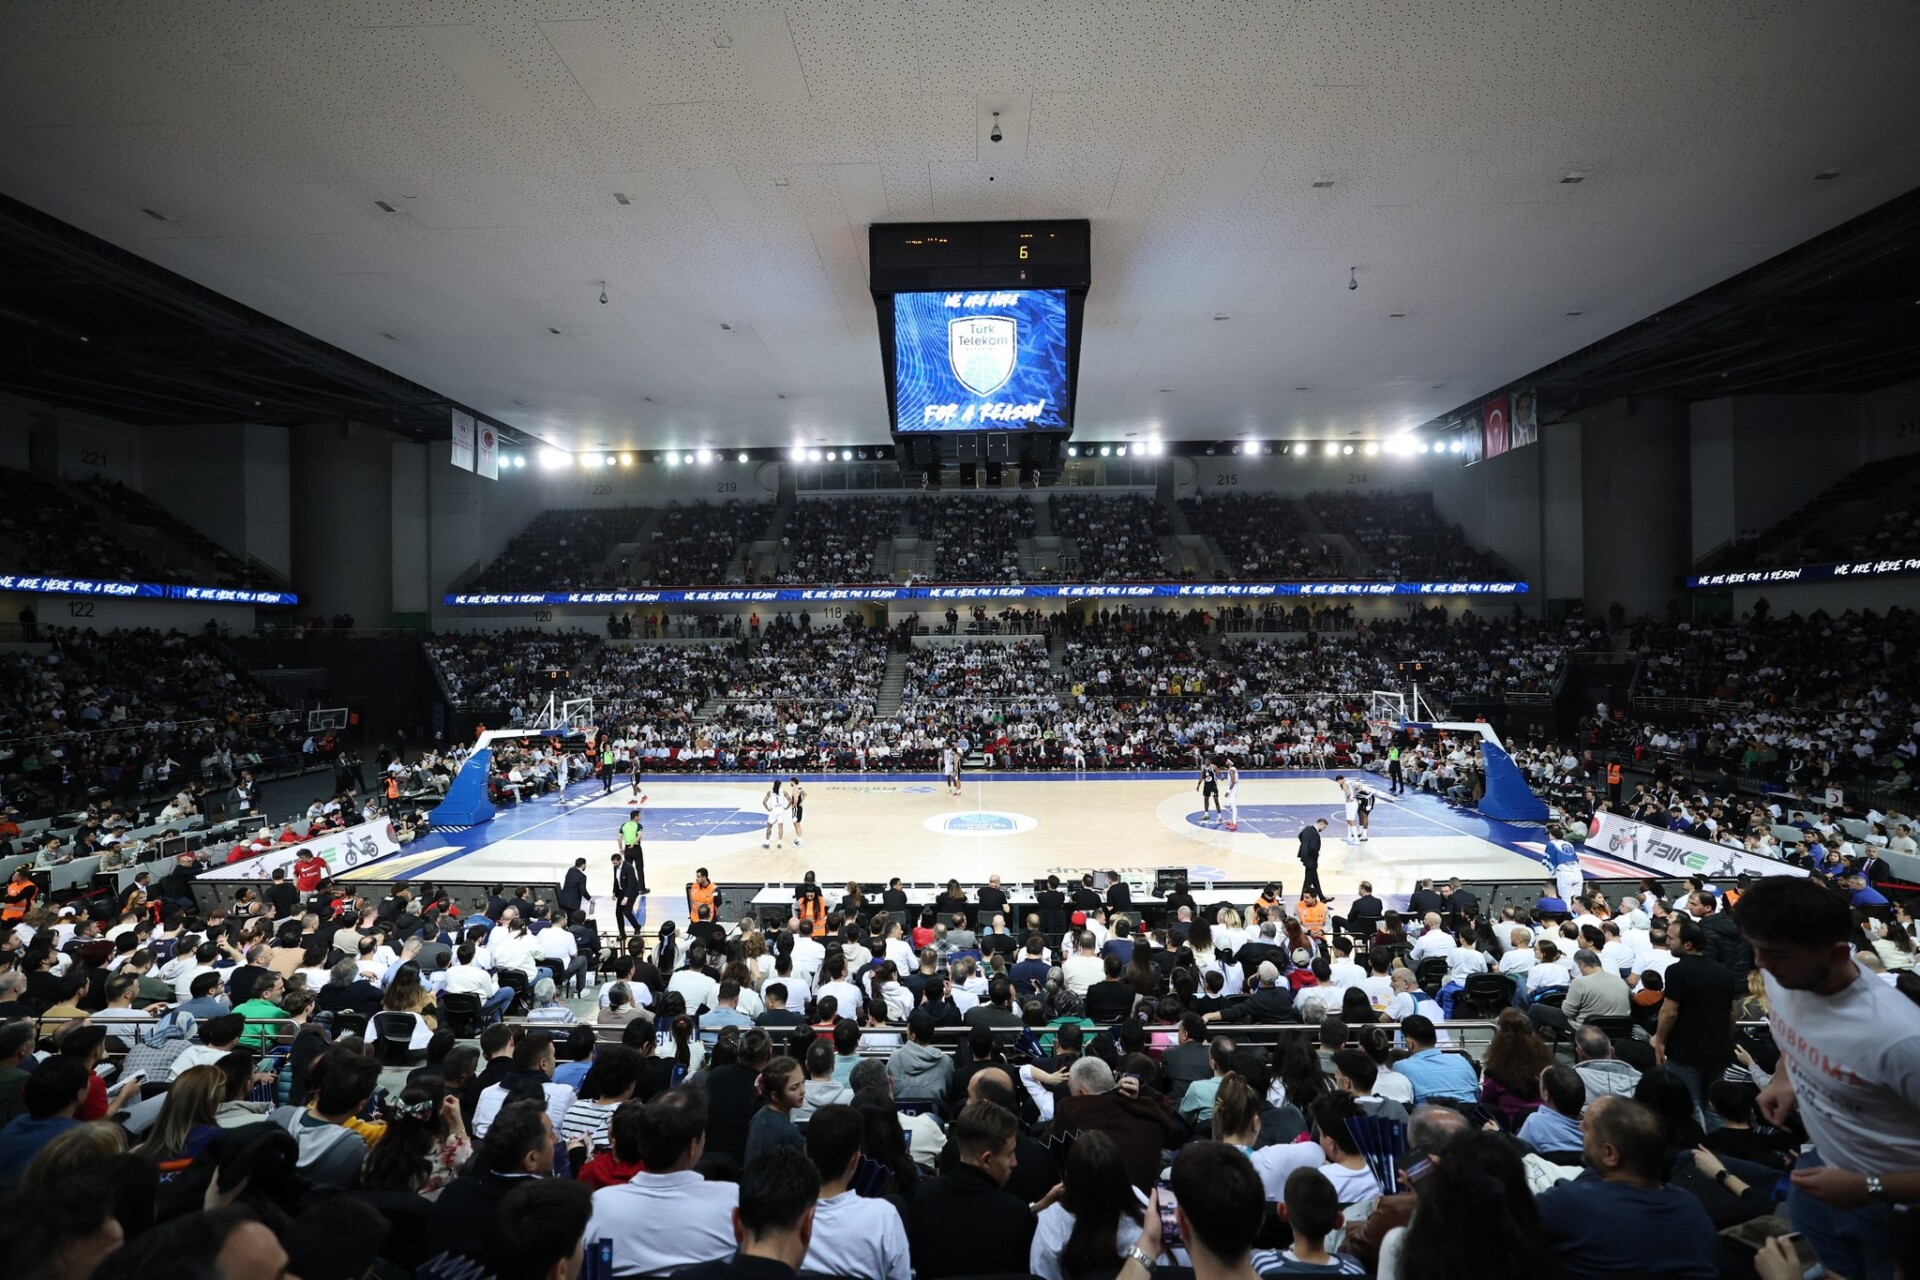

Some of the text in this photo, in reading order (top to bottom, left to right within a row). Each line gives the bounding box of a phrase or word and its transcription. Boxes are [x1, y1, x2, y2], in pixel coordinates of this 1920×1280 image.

[1019, 245, 1028, 259] 6
[944, 291, 1019, 308] WE ARE HERE
[969, 322, 995, 334] Türk
[958, 334, 1008, 346] Telekom
[923, 398, 1046, 424] FOR A REASON
[81, 449, 106, 467] 221
[1217, 474, 1238, 486] 215
[592, 484, 612, 496] 220
[717, 482, 737, 493] 219
[1834, 564, 1850, 575] WE
[1851, 562, 1873, 574] ARE
[1873, 560, 1904, 574] HERE
[1698, 575, 1710, 585] WE
[1710, 574, 1725, 584] ARE
[1725, 573, 1747, 584] HERE
[1747, 572, 1762, 581] FOR
[1770, 568, 1802, 580] REASON
[17, 578, 40, 589] ARE
[42, 578, 72, 591] HERE
[73, 581, 93, 592] FOR
[94, 583, 102, 592] A
[103, 583, 138, 595] REASON
[68, 601, 95, 618] 122
[823, 607, 842, 619] 118
[968, 604, 987, 617] 17
[1114, 603, 1133, 615] 16
[534, 610, 552, 622] 120
